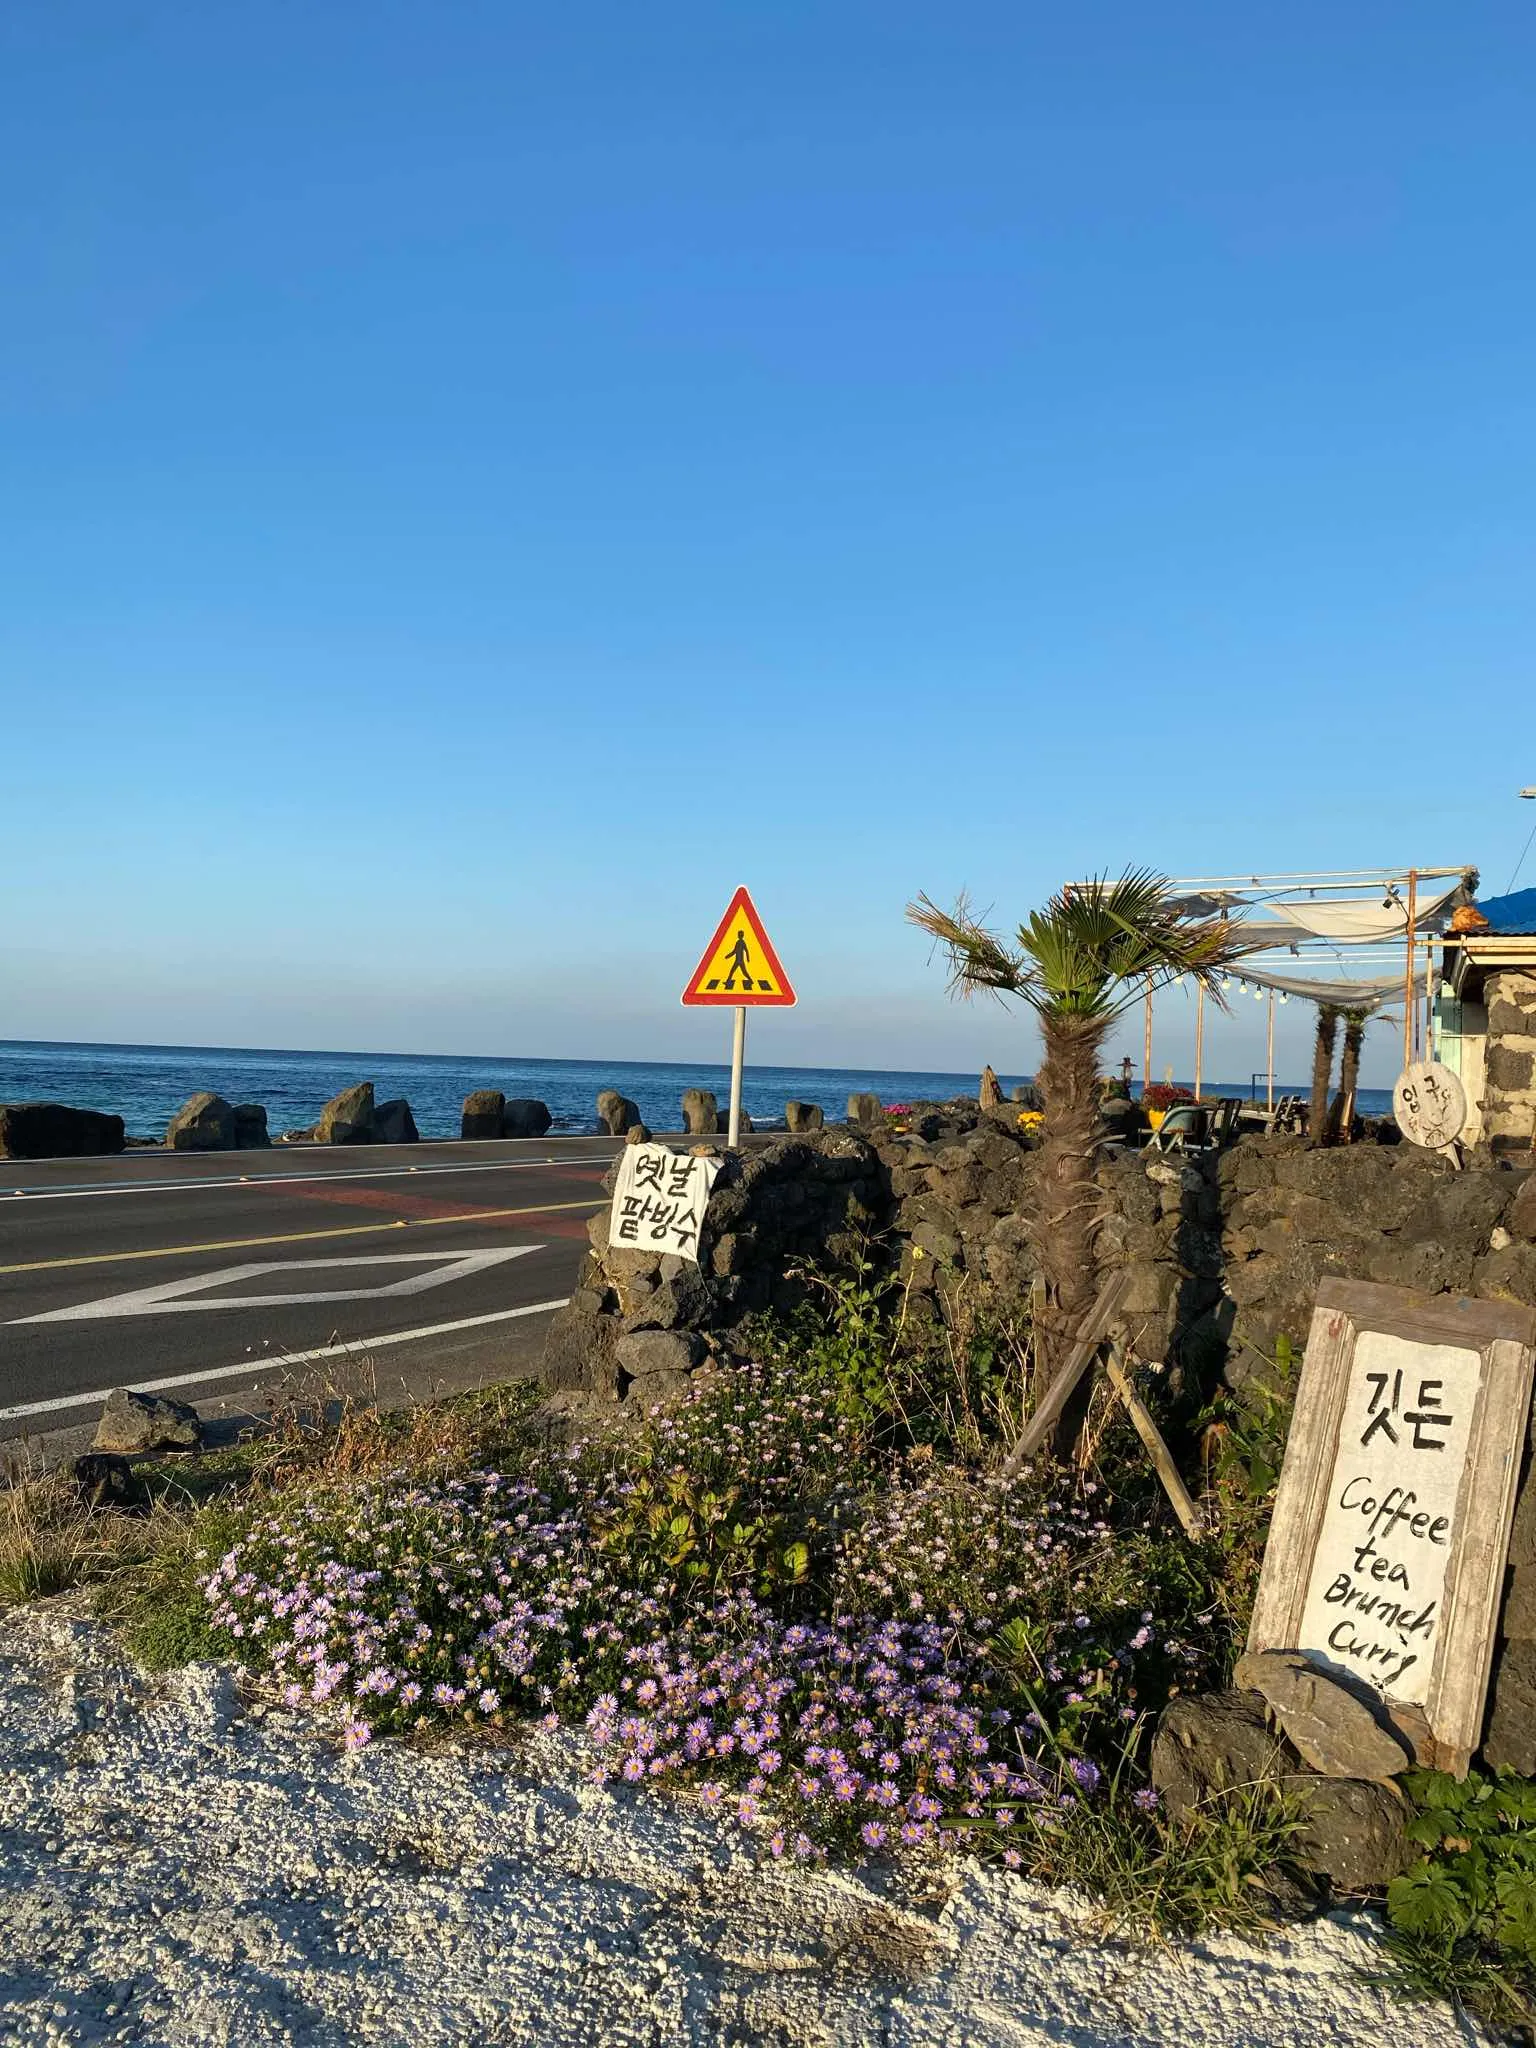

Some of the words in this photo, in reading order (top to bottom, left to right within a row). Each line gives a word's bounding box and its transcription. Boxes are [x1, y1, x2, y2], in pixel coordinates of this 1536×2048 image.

[635, 1154, 698, 1198] 옛날
[619, 1195, 698, 1248] 팥빙수
[1361, 1369, 1453, 1451] 깃든
[1340, 1476, 1449, 1545] Coffee
[1353, 1536, 1409, 1591] tea
[1323, 1573, 1436, 1640] Brunch
[1327, 1620, 1418, 1686] Curry
